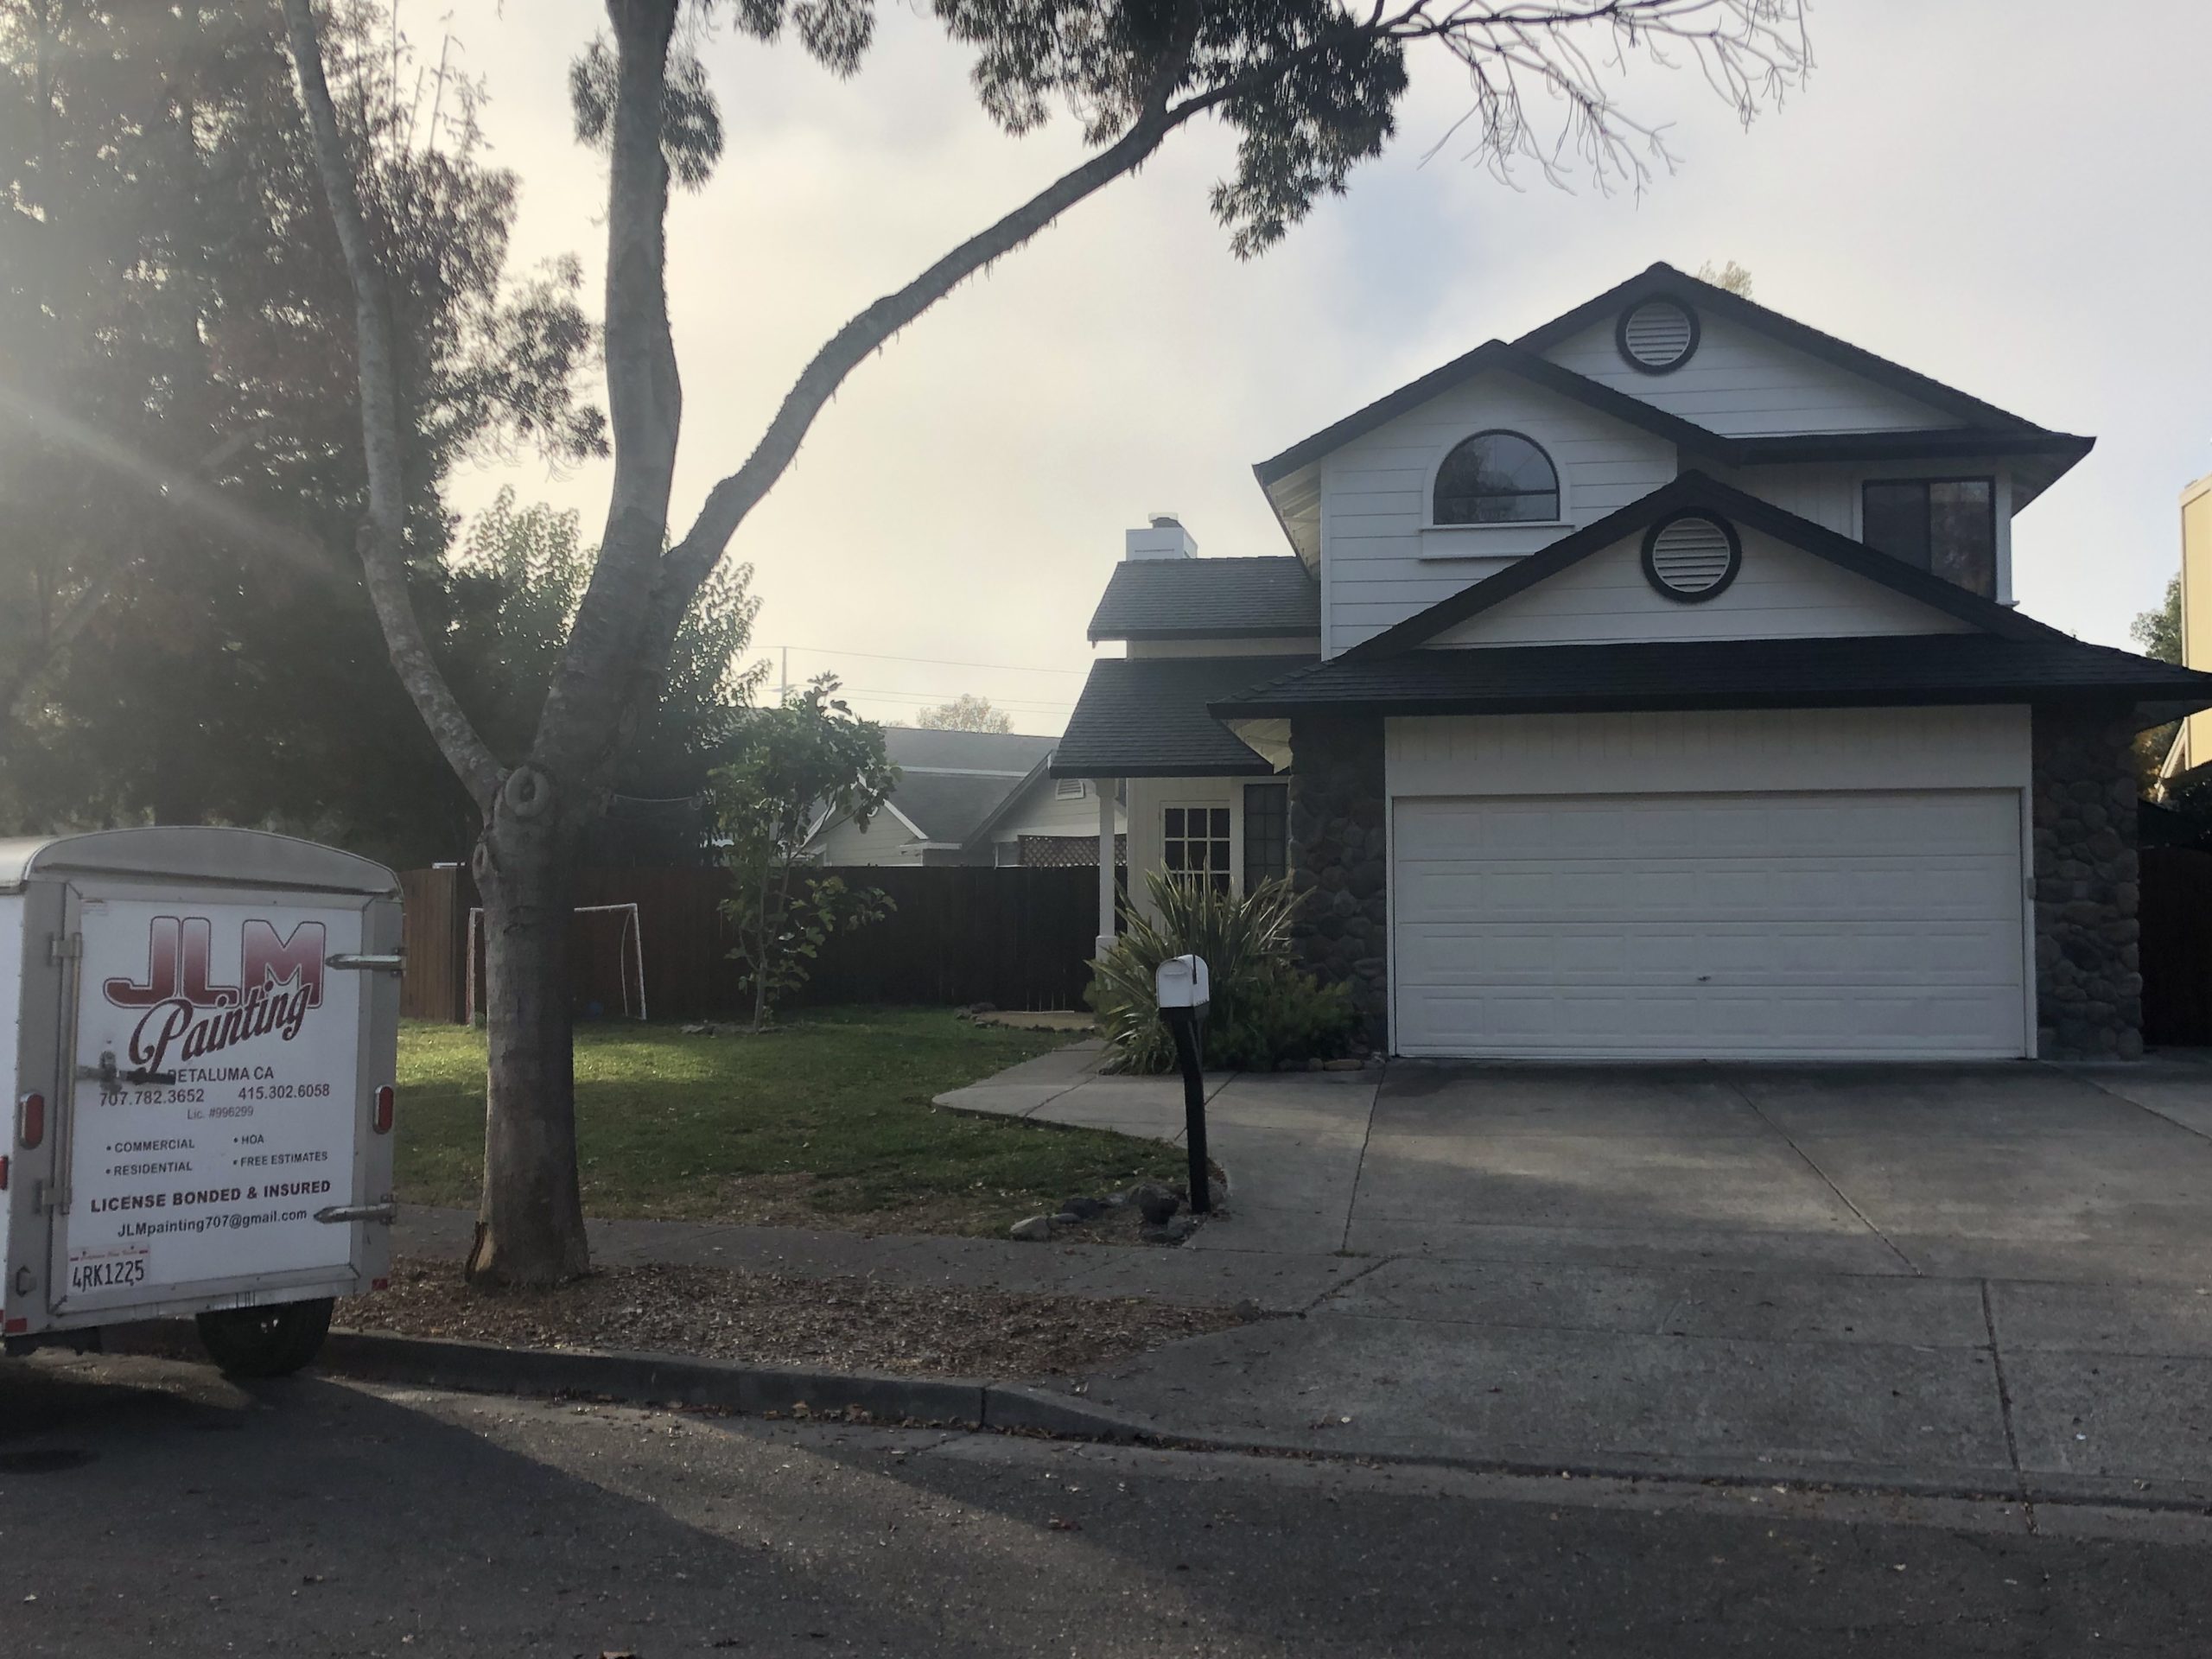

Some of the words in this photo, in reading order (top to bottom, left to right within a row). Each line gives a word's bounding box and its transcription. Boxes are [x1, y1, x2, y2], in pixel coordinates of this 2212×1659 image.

[103, 916, 326, 1008] JLM
[129, 980, 312, 1073] Painting
[253, 1066, 274, 1080] CA
[100, 1089, 205, 1106] 707.782.3652
[238, 1084, 330, 1099] 415.302.6058
[114, 1139, 195, 1153] COMMERCIAL
[241, 1134, 264, 1145] HOA
[240, 1155, 268, 1166] FREE
[270, 1151, 328, 1165] ESTIMATES
[113, 1161, 193, 1176] RESIDENTIAL
[91, 1193, 167, 1212] LICENSE
[173, 1188, 241, 1206] BONDED
[247, 1186, 257, 1199] &
[264, 1180, 331, 1198] INSURED
[118, 1210, 307, 1237] JLMpainting707@gmail.com
[73, 1259, 144, 1289] 4RK1225
